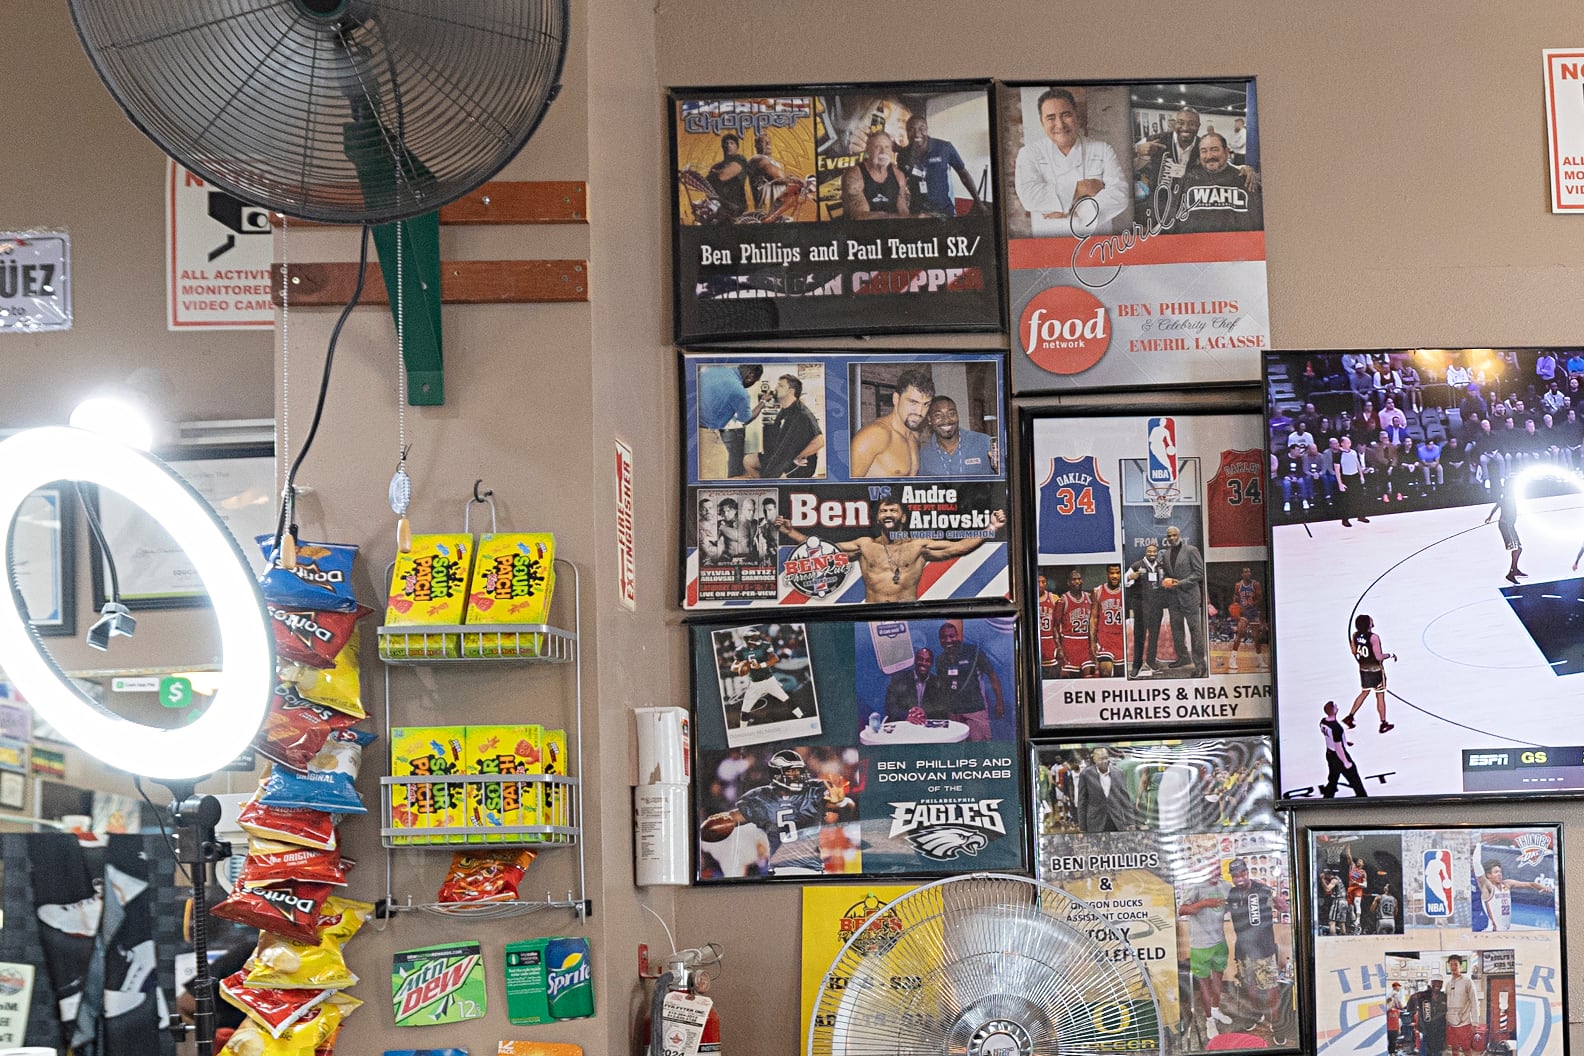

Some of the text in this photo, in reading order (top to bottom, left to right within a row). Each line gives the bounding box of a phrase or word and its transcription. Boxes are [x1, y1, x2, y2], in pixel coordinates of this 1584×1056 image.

[1193, 188, 1244, 206] WAHL
[1069, 182, 1201, 288] Emeril's
[700, 235, 981, 267] Ben Phillips and Paul Teutul SR/
[181, 269, 209, 281] ALL
[852, 267, 984, 296] CHOPPER
[181, 284, 272, 296] MONITORED
[182, 300, 229, 311] VIDEO
[1117, 300, 1240, 318] BEN PHILLIPS
[1025, 307, 1107, 356] food
[1157, 316, 1208, 333] Celebrity
[1211, 316, 1240, 331] Chef
[1042, 339, 1086, 350] network
[1129, 334, 1266, 353] EMERIL LAGASSE
[1056, 472, 1093, 487] OAKLEY
[1151, 468, 1170, 480] NBA
[901, 485, 958, 504] Andre
[1056, 486, 1096, 516] 34
[1227, 477, 1263, 506] 34
[789, 491, 871, 528] Ben
[617, 502, 626, 546] FIRE
[909, 509, 991, 530] Arlovski
[622, 461, 635, 601] EXTINGUISHER
[909, 530, 944, 540] WORLD
[945, 529, 996, 540] CHAMPION
[1133, 536, 1160, 548] FROM
[783, 552, 850, 576] BEN'S
[413, 556, 434, 602] PATCH
[431, 555, 450, 598] SOUR
[495, 554, 514, 600] PATCH
[512, 553, 531, 597] SOUR
[726, 590, 777, 598] PAY-PER-VIEW
[1063, 684, 1273, 706] BEN PHILLIPS & NBA STAR
[1099, 703, 1239, 721] CHARLES OAKLEY
[877, 757, 1012, 771] BEN PHILLIPS AND
[1468, 754, 1511, 767] ESPN
[1520, 750, 1548, 765] GS
[878, 769, 1012, 783] DONOVAN MCNABB
[927, 784, 963, 793] OF THE
[920, 797, 976, 805] PHILADELPHIA
[776, 807, 799, 844] 5
[887, 798, 1007, 839] EAGLES
[1051, 852, 1160, 873] BEN PHILLIPS
[1099, 877, 1113, 891] &
[1112, 899, 1144, 909] DUCKS
[1248, 893, 1261, 926] WAHL
[1427, 902, 1446, 914] NBA
[1116, 910, 1149, 921] COACH
[547, 959, 592, 997] Sprite
[457, 999, 476, 1019] 12
